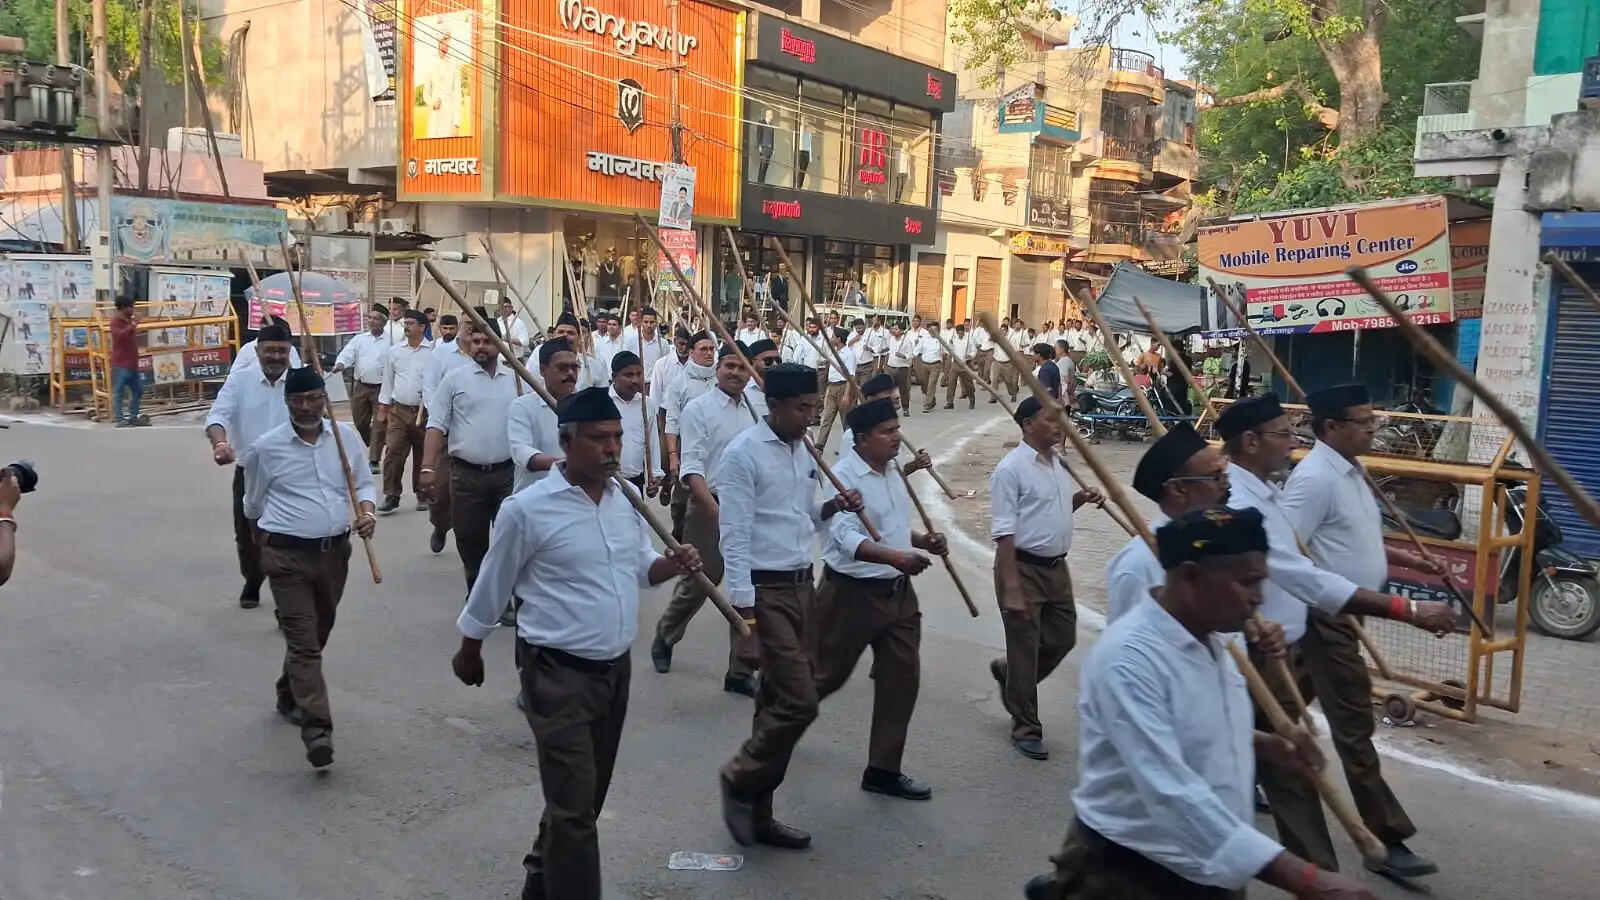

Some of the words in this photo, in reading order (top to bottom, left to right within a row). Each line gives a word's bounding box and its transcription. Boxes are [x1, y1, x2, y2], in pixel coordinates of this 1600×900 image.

[424, 158, 480, 175] मान्यवर
[1267, 212, 1358, 244] YUVI
[1219, 250, 1270, 268] Mobile
[1275, 242, 1350, 263] Reparing
[1356, 236, 1415, 255] Center
[1397, 262, 1416, 271] Jio
[1331, 313, 1441, 331] Mob-79854218
